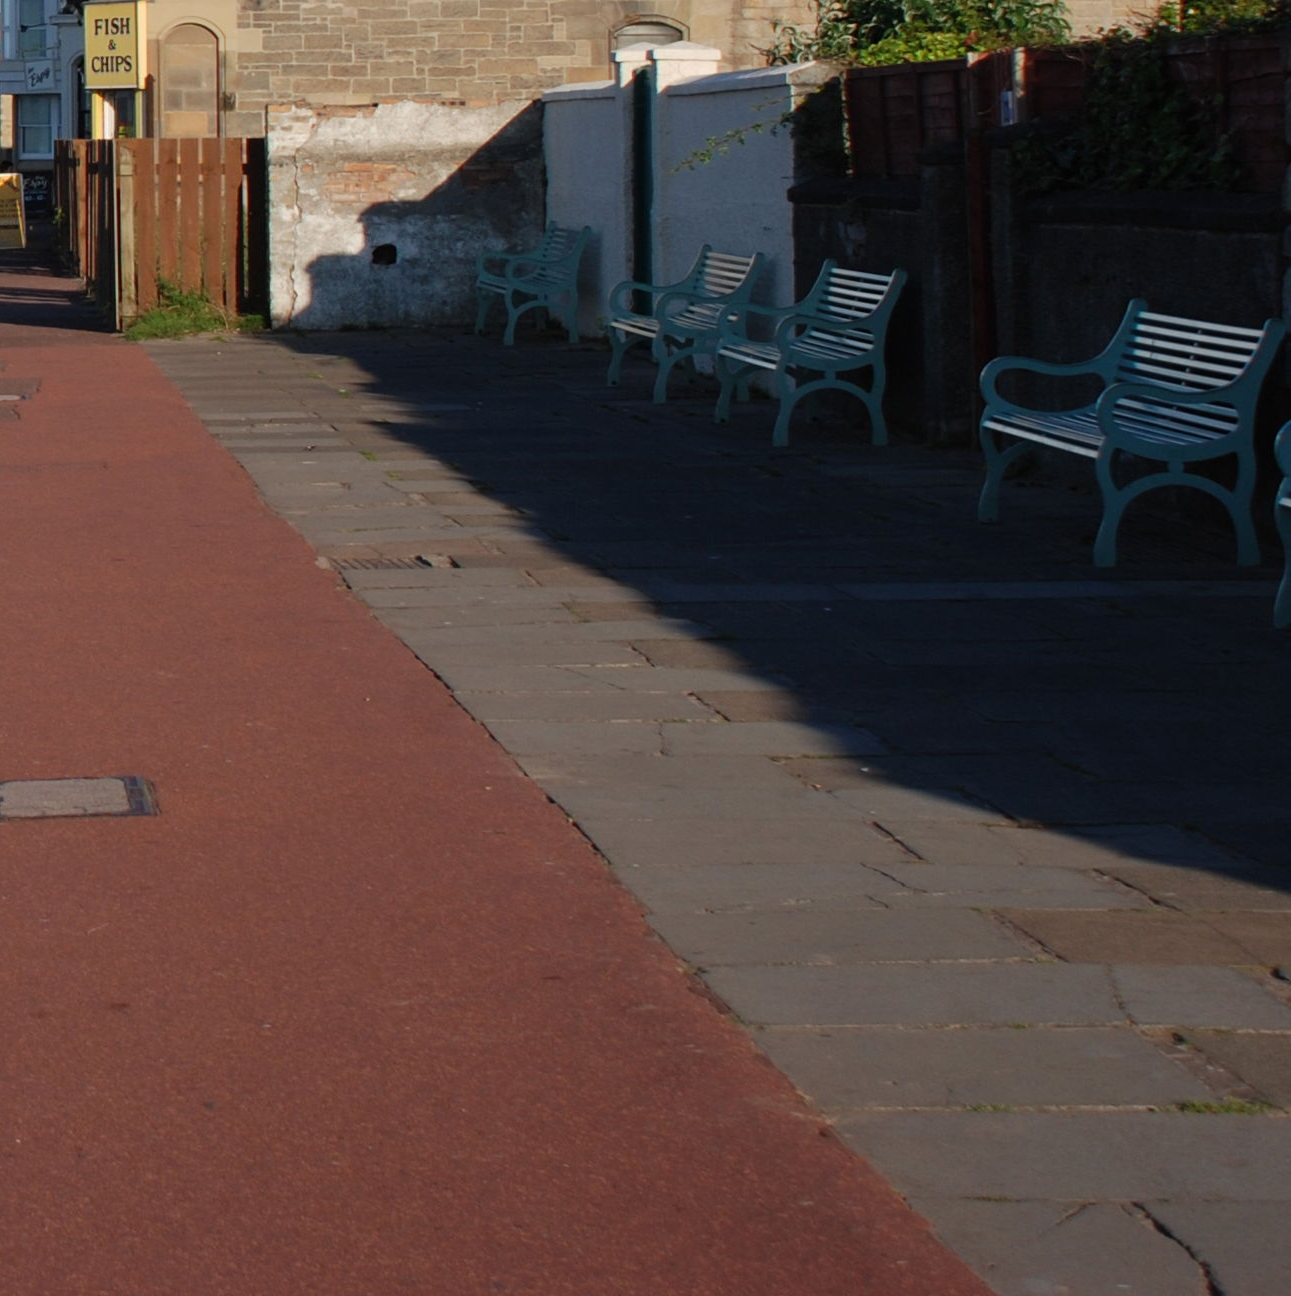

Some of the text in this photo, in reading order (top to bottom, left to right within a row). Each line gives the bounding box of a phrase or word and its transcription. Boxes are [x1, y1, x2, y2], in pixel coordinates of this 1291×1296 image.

[94, 17, 130, 35] FISH
[108, 39, 116, 50] &
[91, 55, 132, 73] CHIPS
